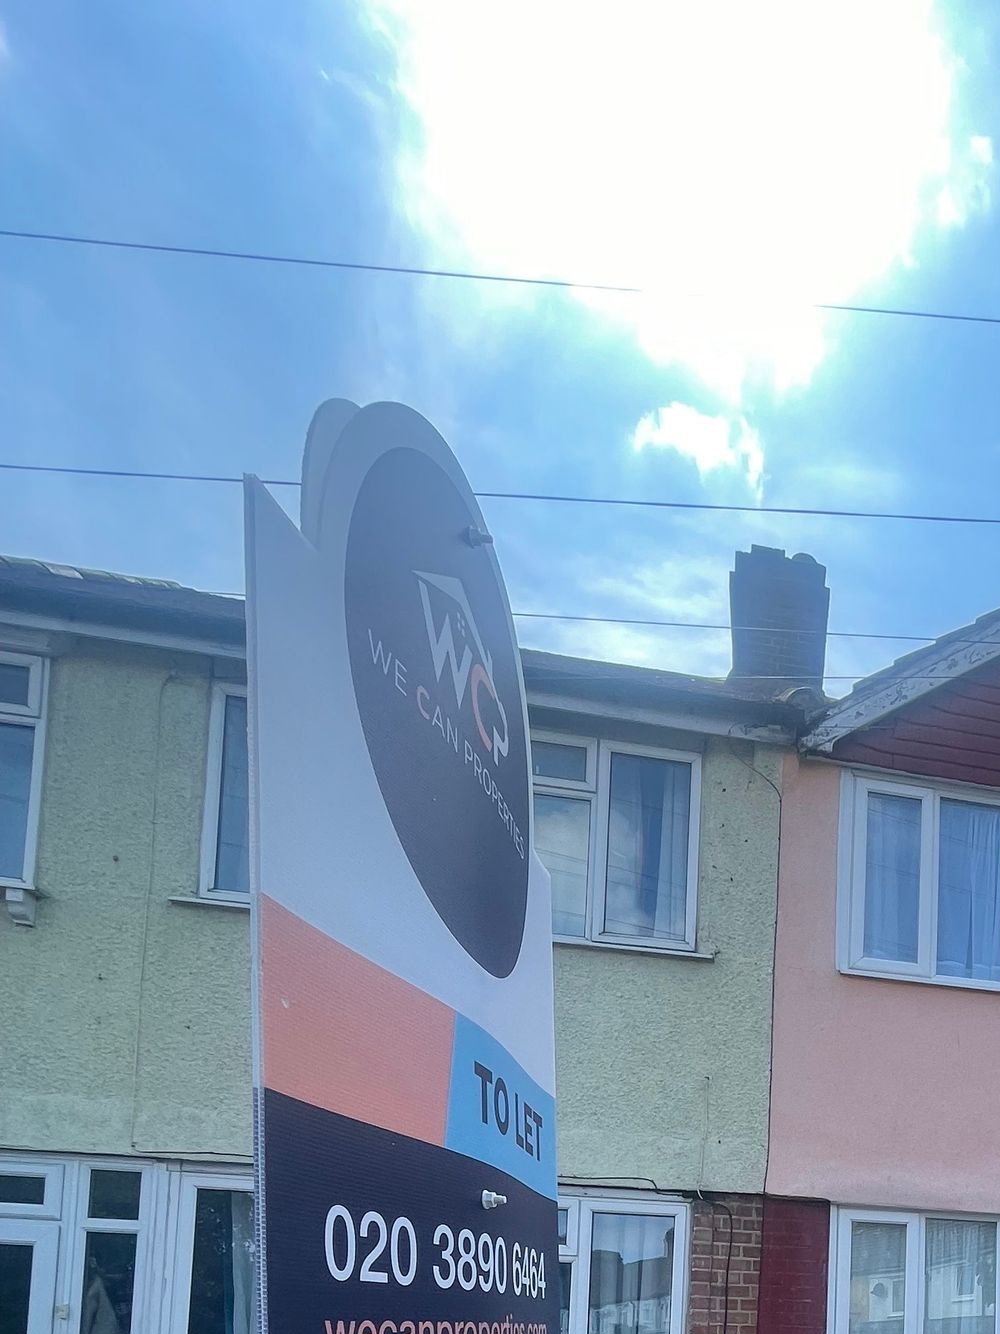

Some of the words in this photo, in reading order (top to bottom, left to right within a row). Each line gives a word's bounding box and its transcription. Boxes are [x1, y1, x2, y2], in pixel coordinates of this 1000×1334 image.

[368, 628, 408, 697] WE
[415, 685, 459, 753] CAN
[464, 740, 525, 860] PROPERTIES
[474, 1060, 510, 1136] TO
[515, 1092, 543, 1162] LET
[324, 1204, 418, 1287] 020
[433, 1224, 507, 1294] 3890
[512, 1242, 547, 1299] 6464
